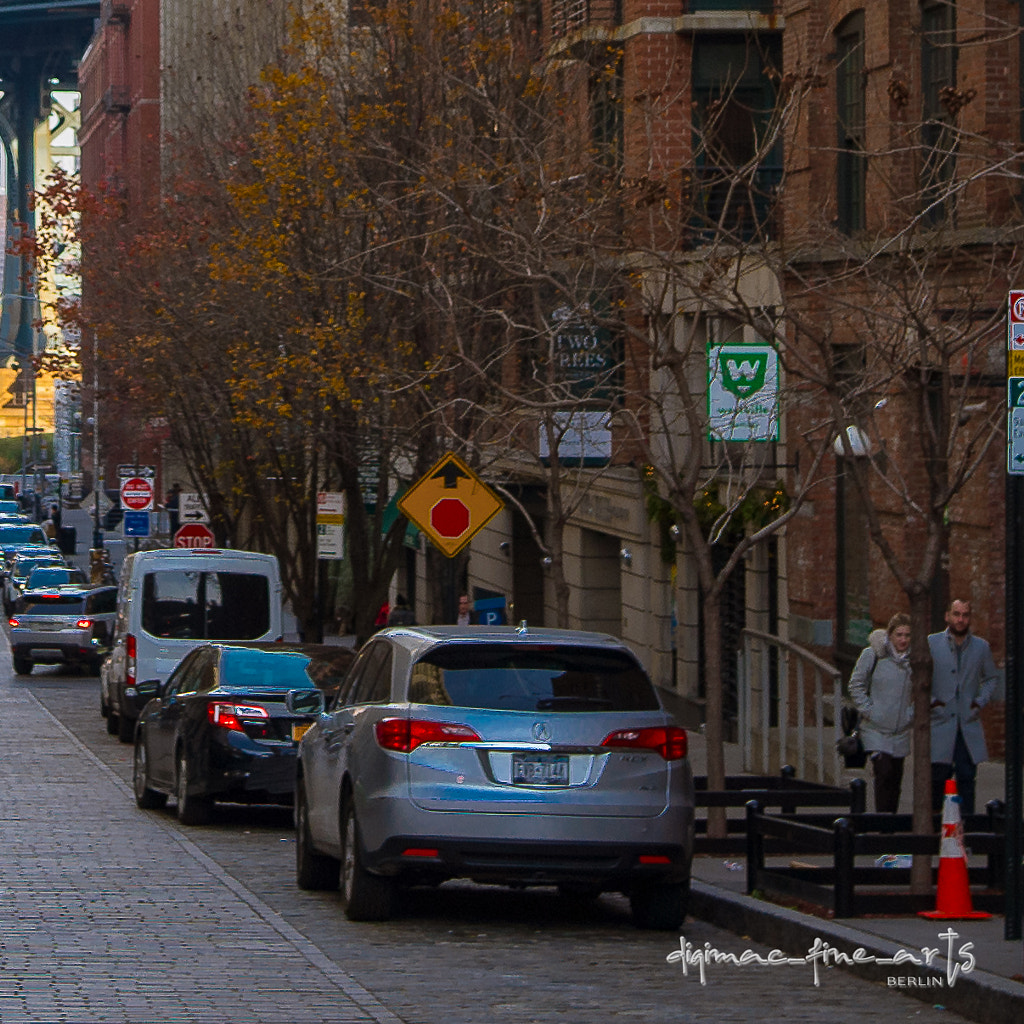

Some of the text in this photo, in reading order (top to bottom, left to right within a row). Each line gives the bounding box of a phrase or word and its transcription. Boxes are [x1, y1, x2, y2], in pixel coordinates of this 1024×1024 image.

[553, 352, 606, 367] REES
[177, 536, 212, 548] STOP
[486, 612, 497, 626] P
